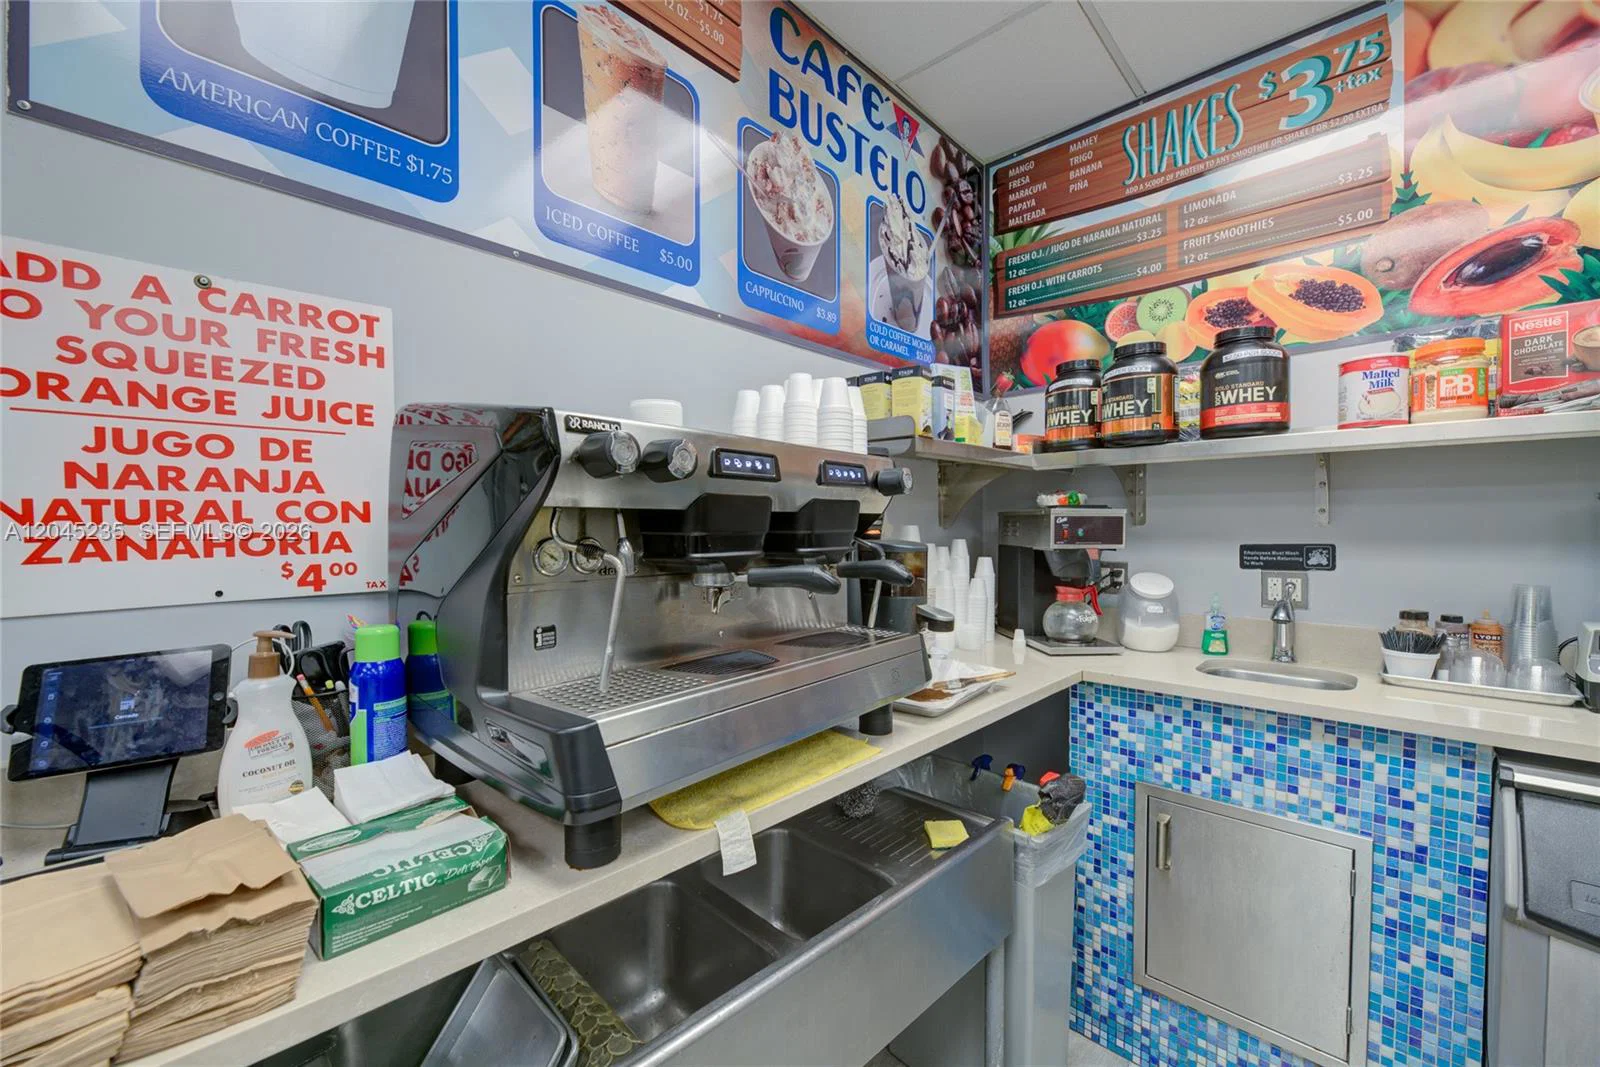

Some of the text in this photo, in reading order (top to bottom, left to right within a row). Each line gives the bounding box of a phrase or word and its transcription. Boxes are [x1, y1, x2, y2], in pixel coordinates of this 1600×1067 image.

[700, 20, 725, 45] $5.00
[1333, 66, 1383, 93] +tax
[157, 66, 453, 185] AMERICAN COFFEE $1.75
[1122, 82, 1244, 186] SHAKES
[769, 67, 926, 215] BUSTELO
[1069, 134, 1099, 153] MAMEY
[1125, 186, 1138, 196] ADD
[1144, 177, 1166, 190] SCOOP
[1175, 164, 1205, 181] PROTEIN
[1205, 160, 1216, 170] TO
[1215, 154, 1231, 166] ANY
[1231, 142, 1270, 159] SMOOTHIE
[1270, 137, 1283, 148] OR
[1283, 129, 1310, 143] SHAKE
[1311, 123, 1328, 134] FOR
[1355, 102, 1384, 120] EXTRA
[1008, 160, 1035, 178] MANGO
[1069, 150, 1093, 167] TRIGO
[1069, 160, 1103, 180] BANANA
[1008, 175, 1030, 190] FRESA
[1008, 181, 1047, 202] MARACUYA
[1008, 198, 1036, 215] PAPAYA
[1182, 190, 1237, 214] LIMONADA
[1183, 166, 1374, 229] 12 oz $3.25
[1008, 207, 1046, 228] MALTEADA
[546, 205, 693, 272] ICED COFFEE $5.00
[1008, 252, 1031, 267] FRESH
[1050, 242, 1070, 256] JUGO
[1071, 237, 1082, 249] DE
[1082, 227, 1121, 245] NARANJA
[1121, 212, 1162, 233] NATURAL
[1182, 217, 1275, 250] FRUIT SMOOTHIES
[1183, 208, 1374, 265] 12 oz $5.00
[1008, 269, 1017, 279] 12
[1136, 227, 1162, 243] $3.25
[1008, 281, 1031, 297] FRESH
[1045, 271, 1066, 286] WITH
[1066, 263, 1103, 281] CARROTS
[1008, 299, 1017, 309] 12
[1136, 262, 1162, 277] $4.00
[0, 251, 380, 338] DD A CARROT
[745, 281, 805, 312] CAPPUCCINO
[74, 299, 231, 348] YOUR
[257, 328, 385, 369] FRESH
[869, 321, 933, 354] COLD COFFEE MOCHA
[870, 334, 880, 346] OR
[880, 338, 910, 357] CARAMEL
[1513, 340, 1564, 356] CHOCOLATE
[1524, 334, 1553, 347] DARK
[56, 335, 326, 391] SQUEEZED
[1362, 368, 1400, 381] Malted
[0, 367, 375, 427] ORANGE JUICE
[1221, 386, 1277, 405] WHEY
[1369, 378, 1394, 390] Milk
[1051, 409, 1092, 426] WHEY
[1103, 399, 1149, 421] WHEY
[582, 419, 621, 433] RANCILIO
[81, 427, 313, 463] JUGO DE
[63, 461, 325, 494] NARANJA
[0, 498, 371, 526] NATURAL CON
[21, 531, 353, 566] ZANAHORIA
[366, 580, 387, 589] TAX
[242, 763, 282, 778] COCONUT
[354, 872, 437, 910] CELTIC
